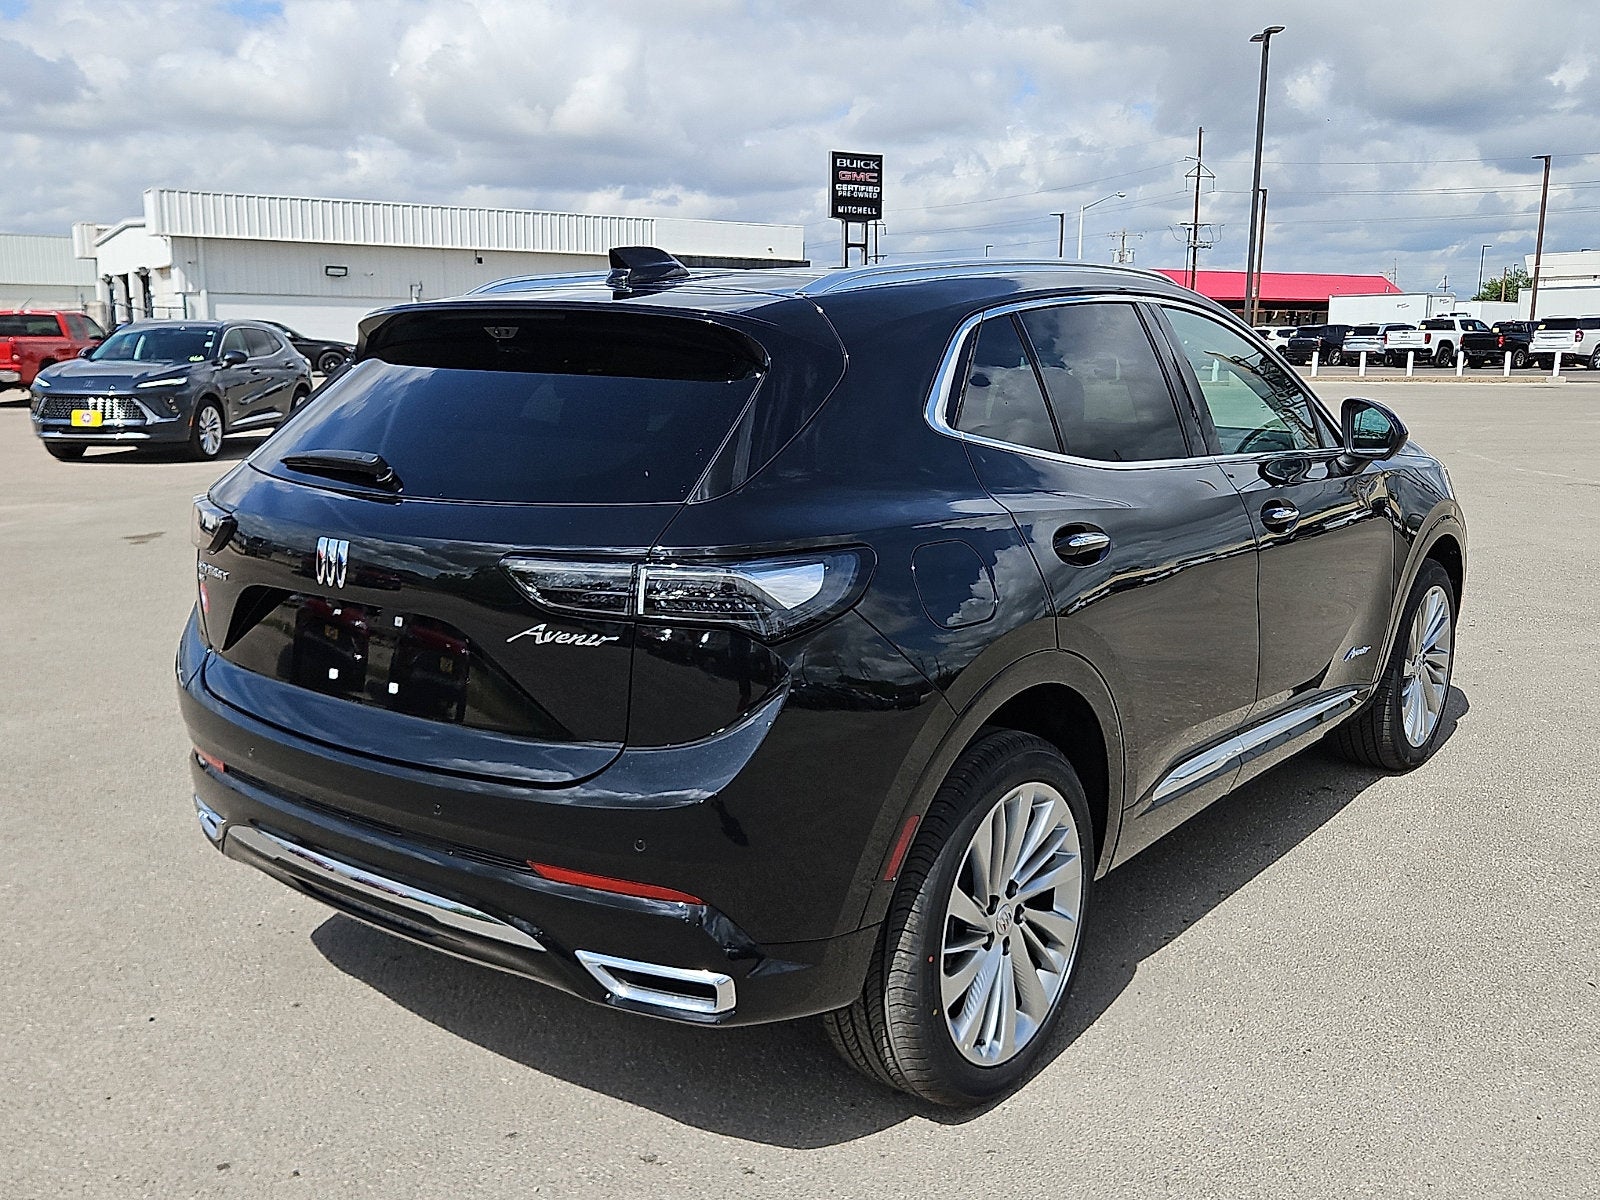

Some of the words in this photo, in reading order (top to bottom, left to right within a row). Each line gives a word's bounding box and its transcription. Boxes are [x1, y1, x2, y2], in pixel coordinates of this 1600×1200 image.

[836, 158, 880, 169] BUICK
[838, 170, 878, 182] GMC
[835, 184, 880, 193] CERTIFIED
[837, 191, 878, 199] PRE-OWNED
[837, 206, 877, 215] MITCHELL
[506, 623, 620, 646] Avenir
